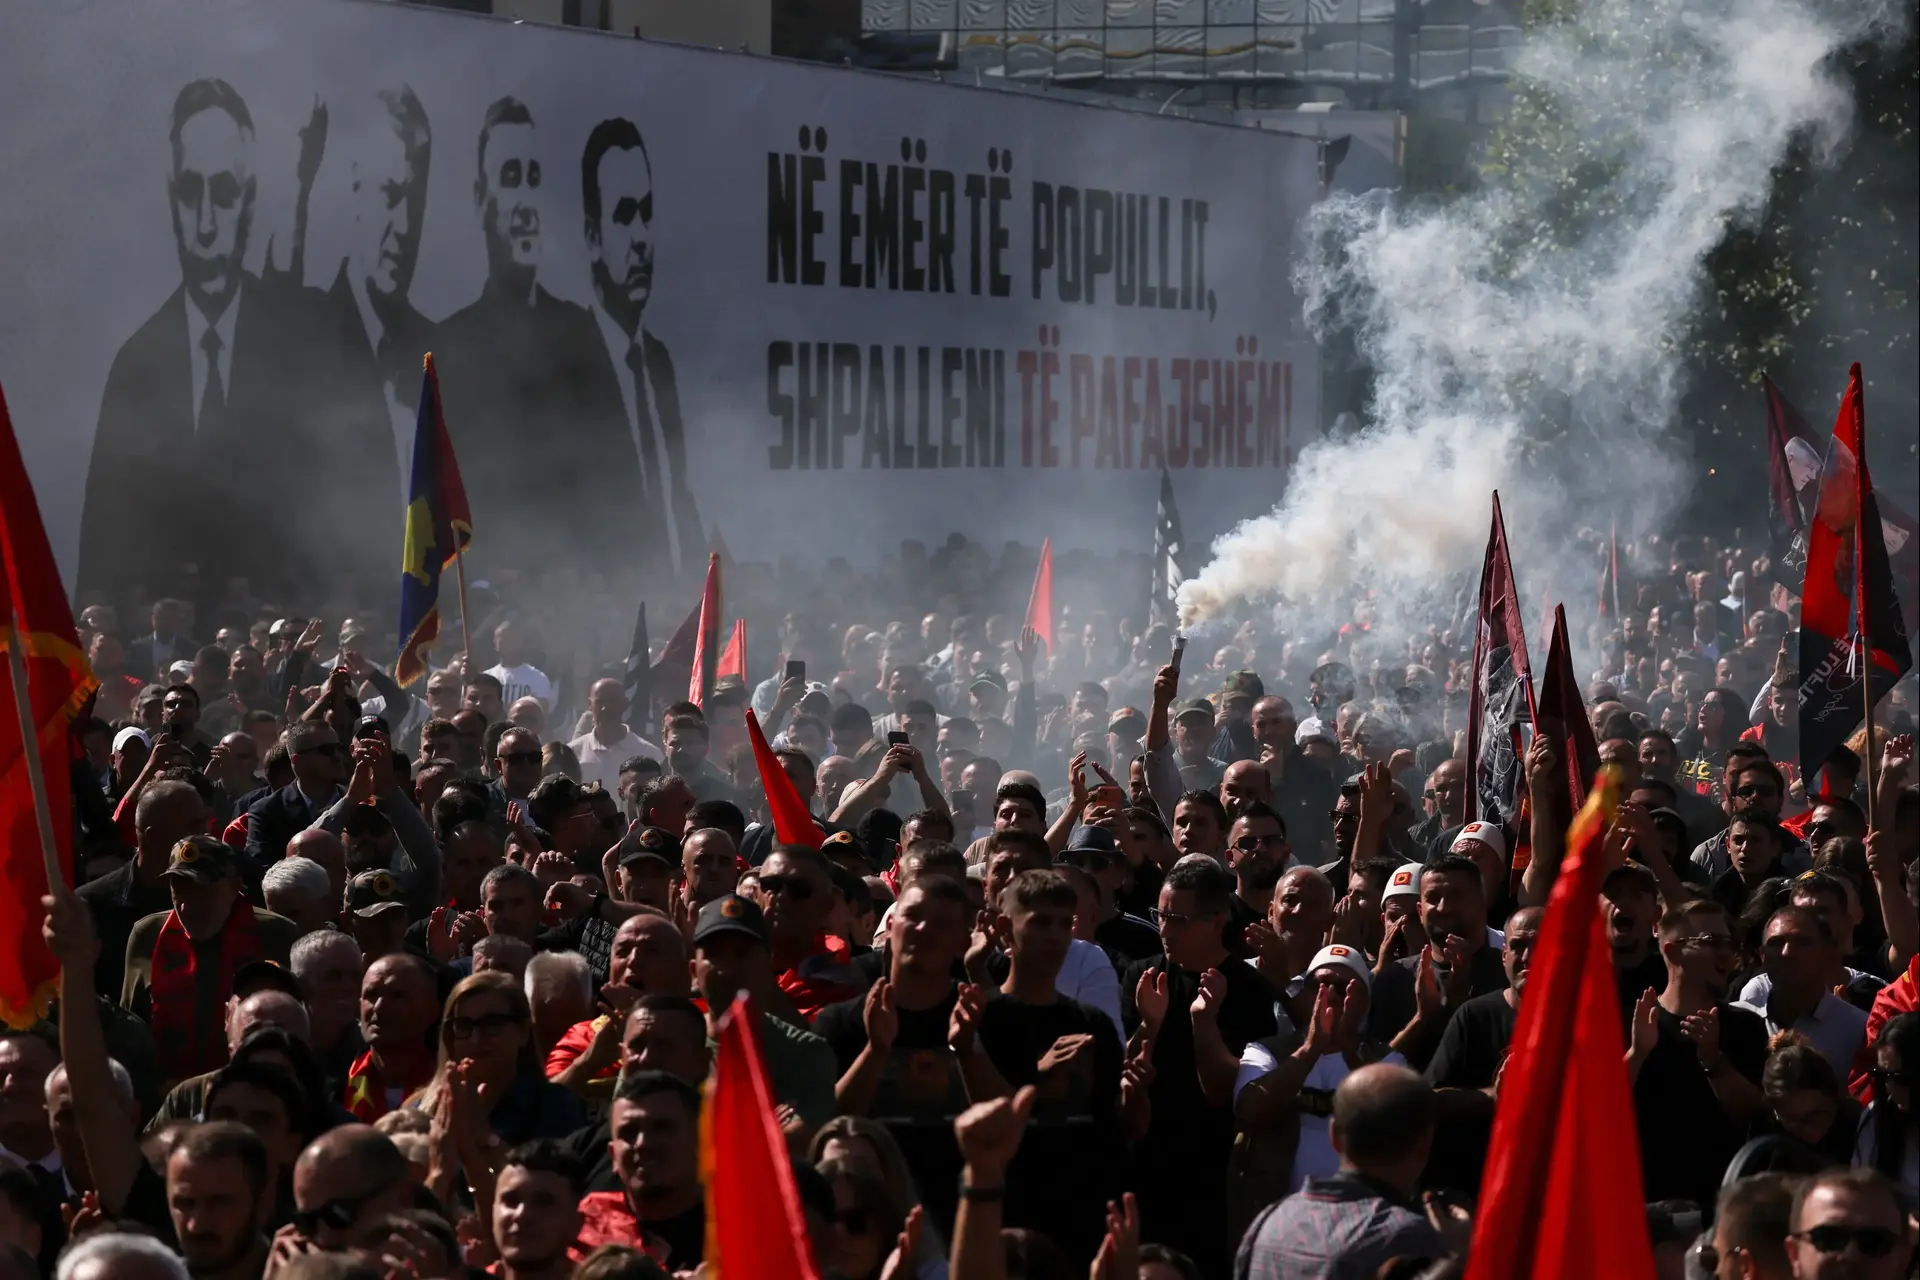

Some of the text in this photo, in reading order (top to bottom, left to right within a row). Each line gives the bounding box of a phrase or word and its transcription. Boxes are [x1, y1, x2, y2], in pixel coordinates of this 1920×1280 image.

[768, 125, 1217, 322] NË EMËR TË POPULLIT,
[768, 324, 1293, 470] SHPALLENI TË PAFAJSHËM!
